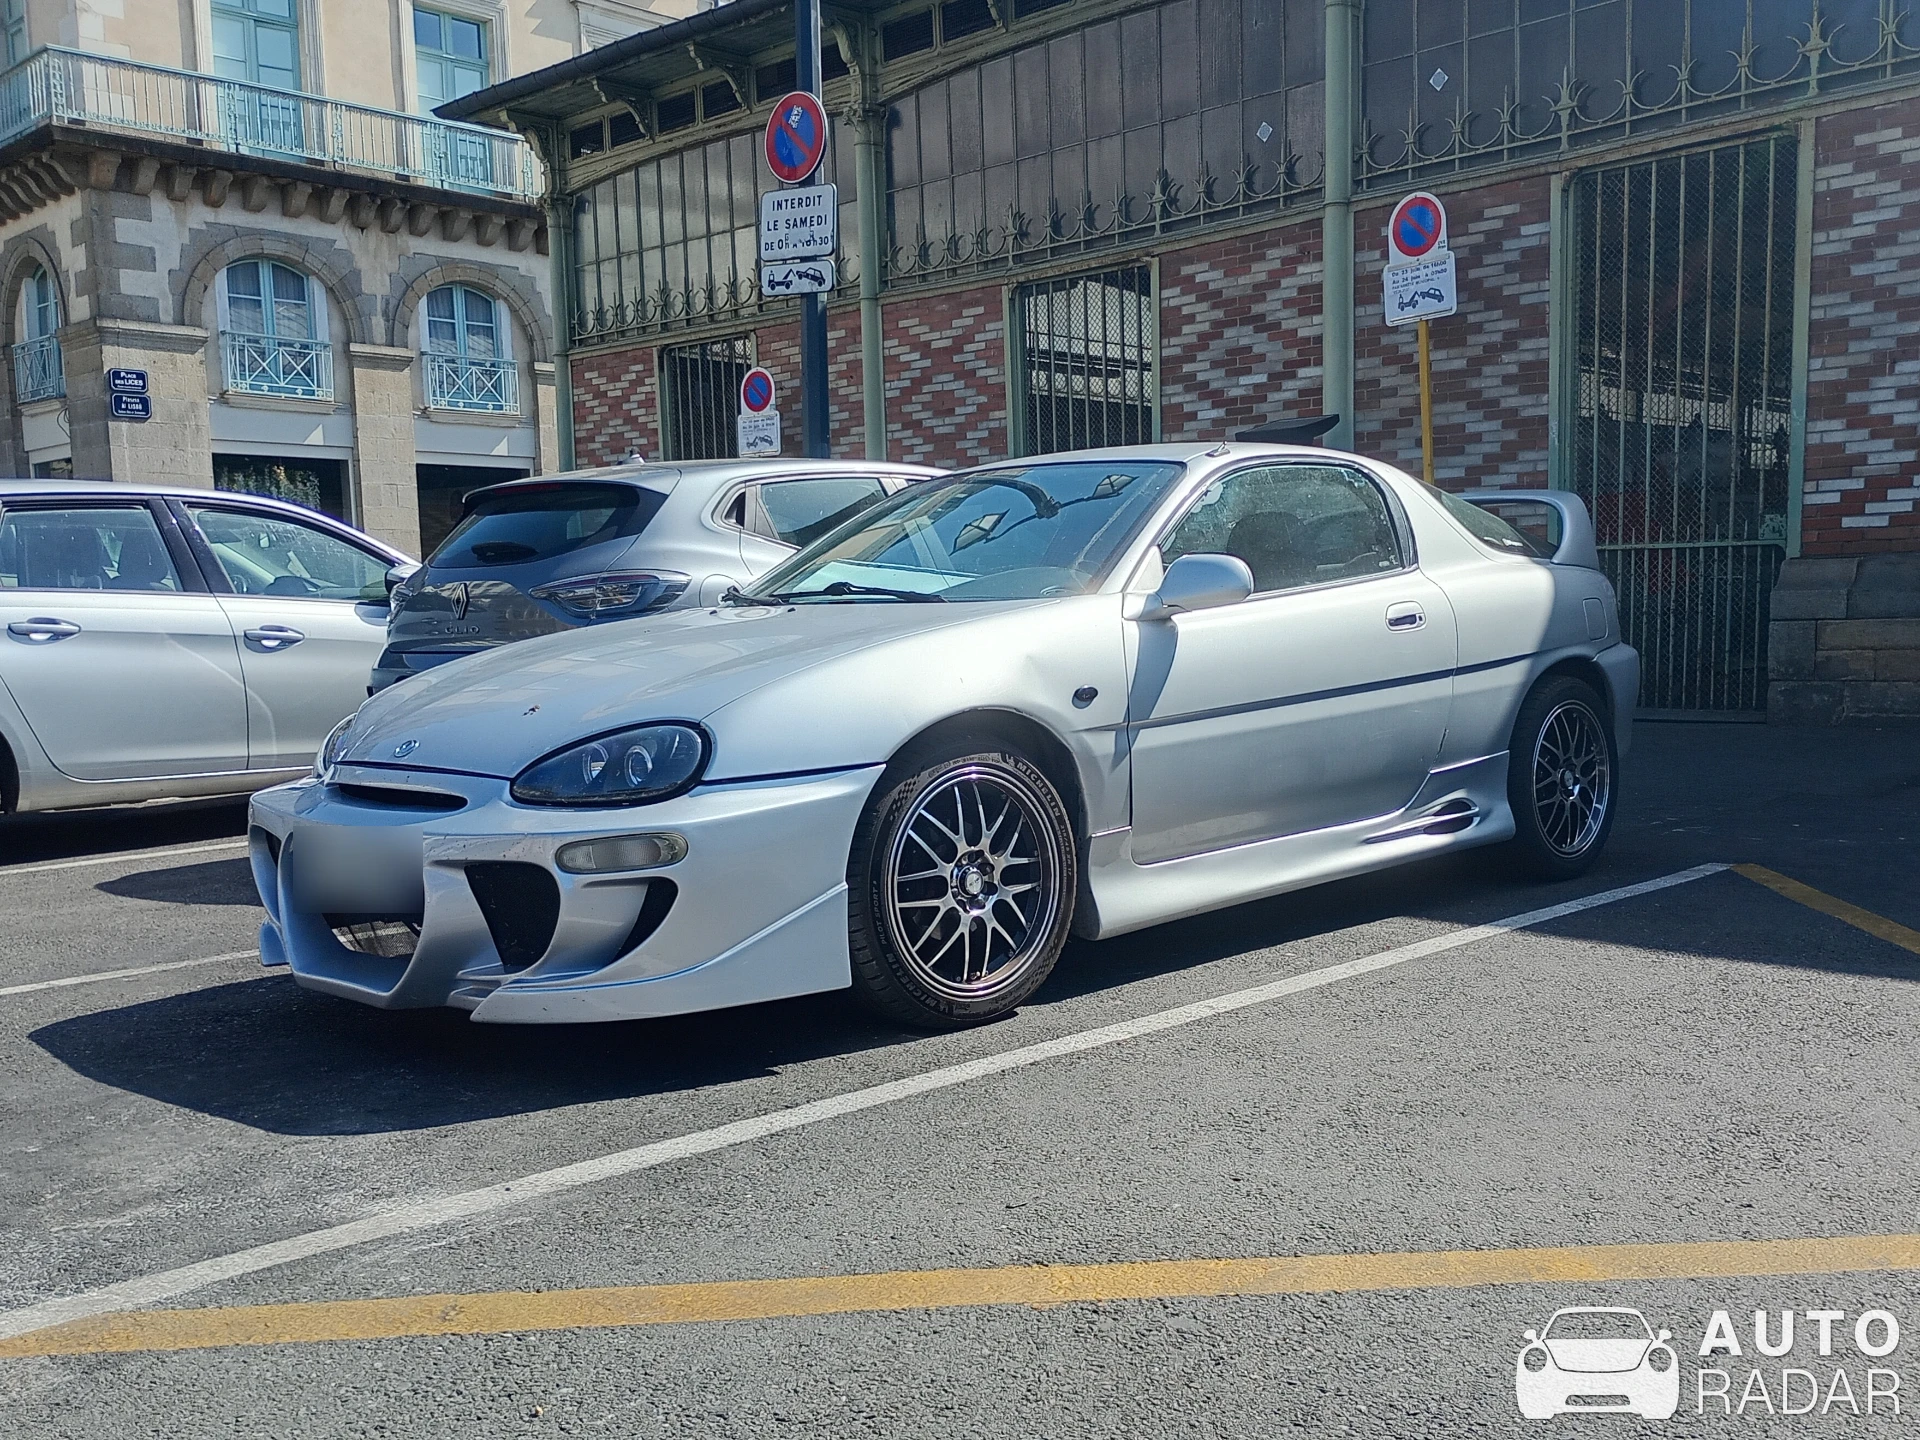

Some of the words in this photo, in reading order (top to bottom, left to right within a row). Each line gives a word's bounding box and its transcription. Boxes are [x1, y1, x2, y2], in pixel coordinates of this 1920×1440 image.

[772, 194, 822, 212] INTERDIT
[766, 219, 779, 232] LE
[784, 214, 828, 230] SAMEDI
[764, 241, 775, 252] DE
[444, 625, 480, 635] CLIO
[1016, 761, 1061, 817] MICHELIN
[872, 886, 881, 919] SPORT
[875, 920, 888, 945] PILOT
[886, 952, 938, 1008] MICHELIN
